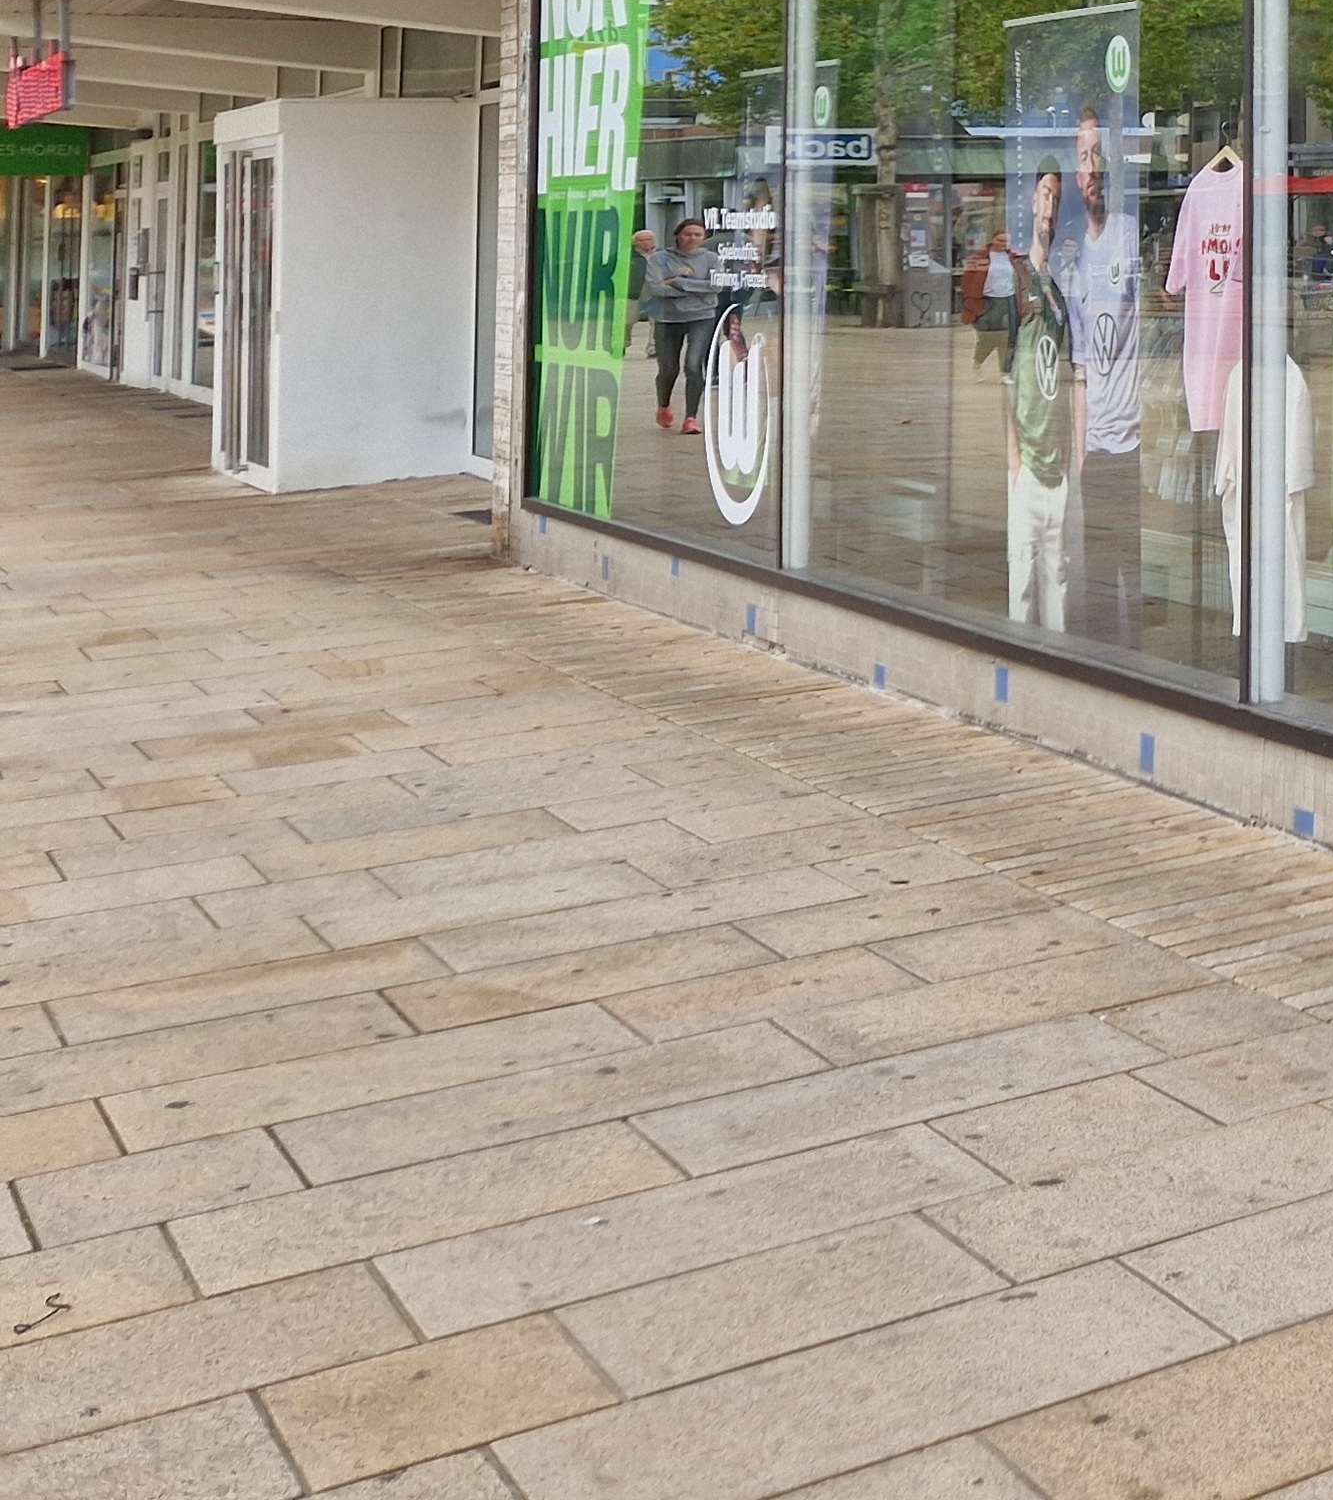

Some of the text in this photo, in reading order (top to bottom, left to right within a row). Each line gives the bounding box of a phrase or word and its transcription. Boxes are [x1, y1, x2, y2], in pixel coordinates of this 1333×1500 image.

[537, 43, 637, 196] HIER.
[538, 205, 620, 351] NUR
[703, 203, 775, 230] VfL Teamstudio
